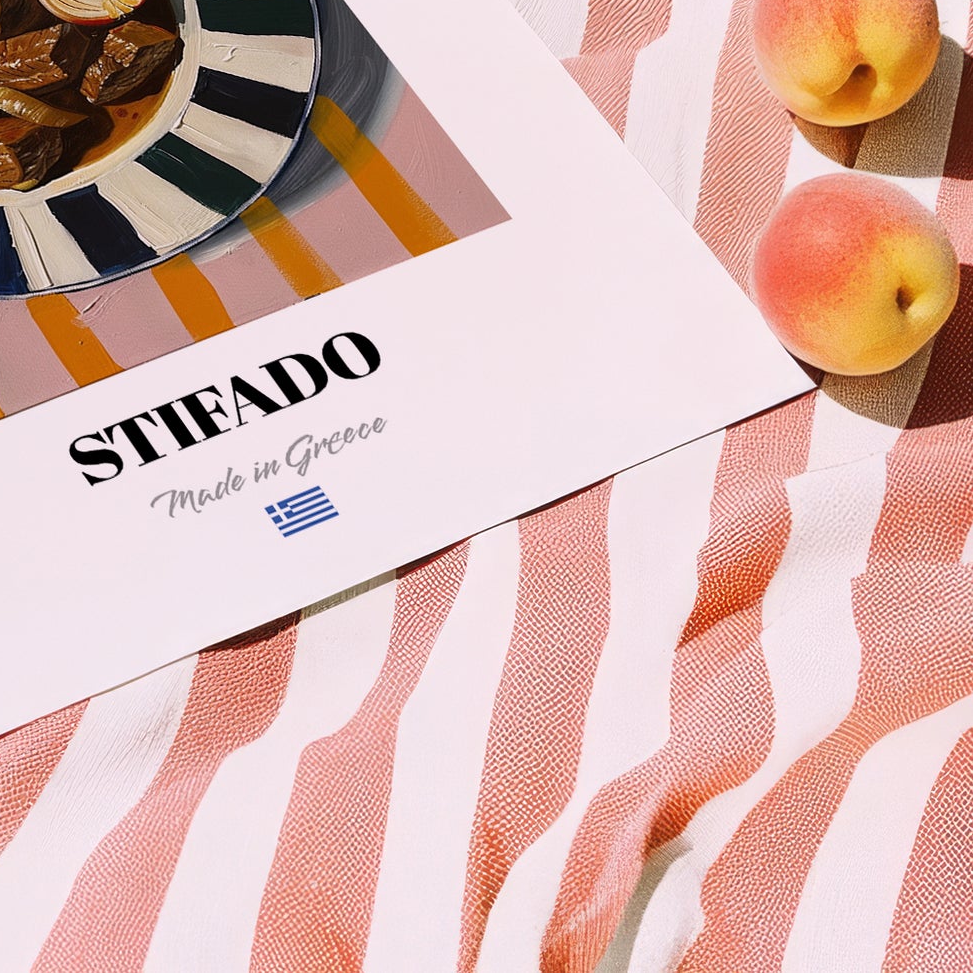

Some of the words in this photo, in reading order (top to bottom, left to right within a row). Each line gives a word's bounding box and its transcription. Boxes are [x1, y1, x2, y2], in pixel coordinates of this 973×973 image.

[68, 331, 382, 487] STIFADO
[150, 467, 247, 518] Made
[253, 458, 283, 484] in
[284, 416, 388, 478] Greece
